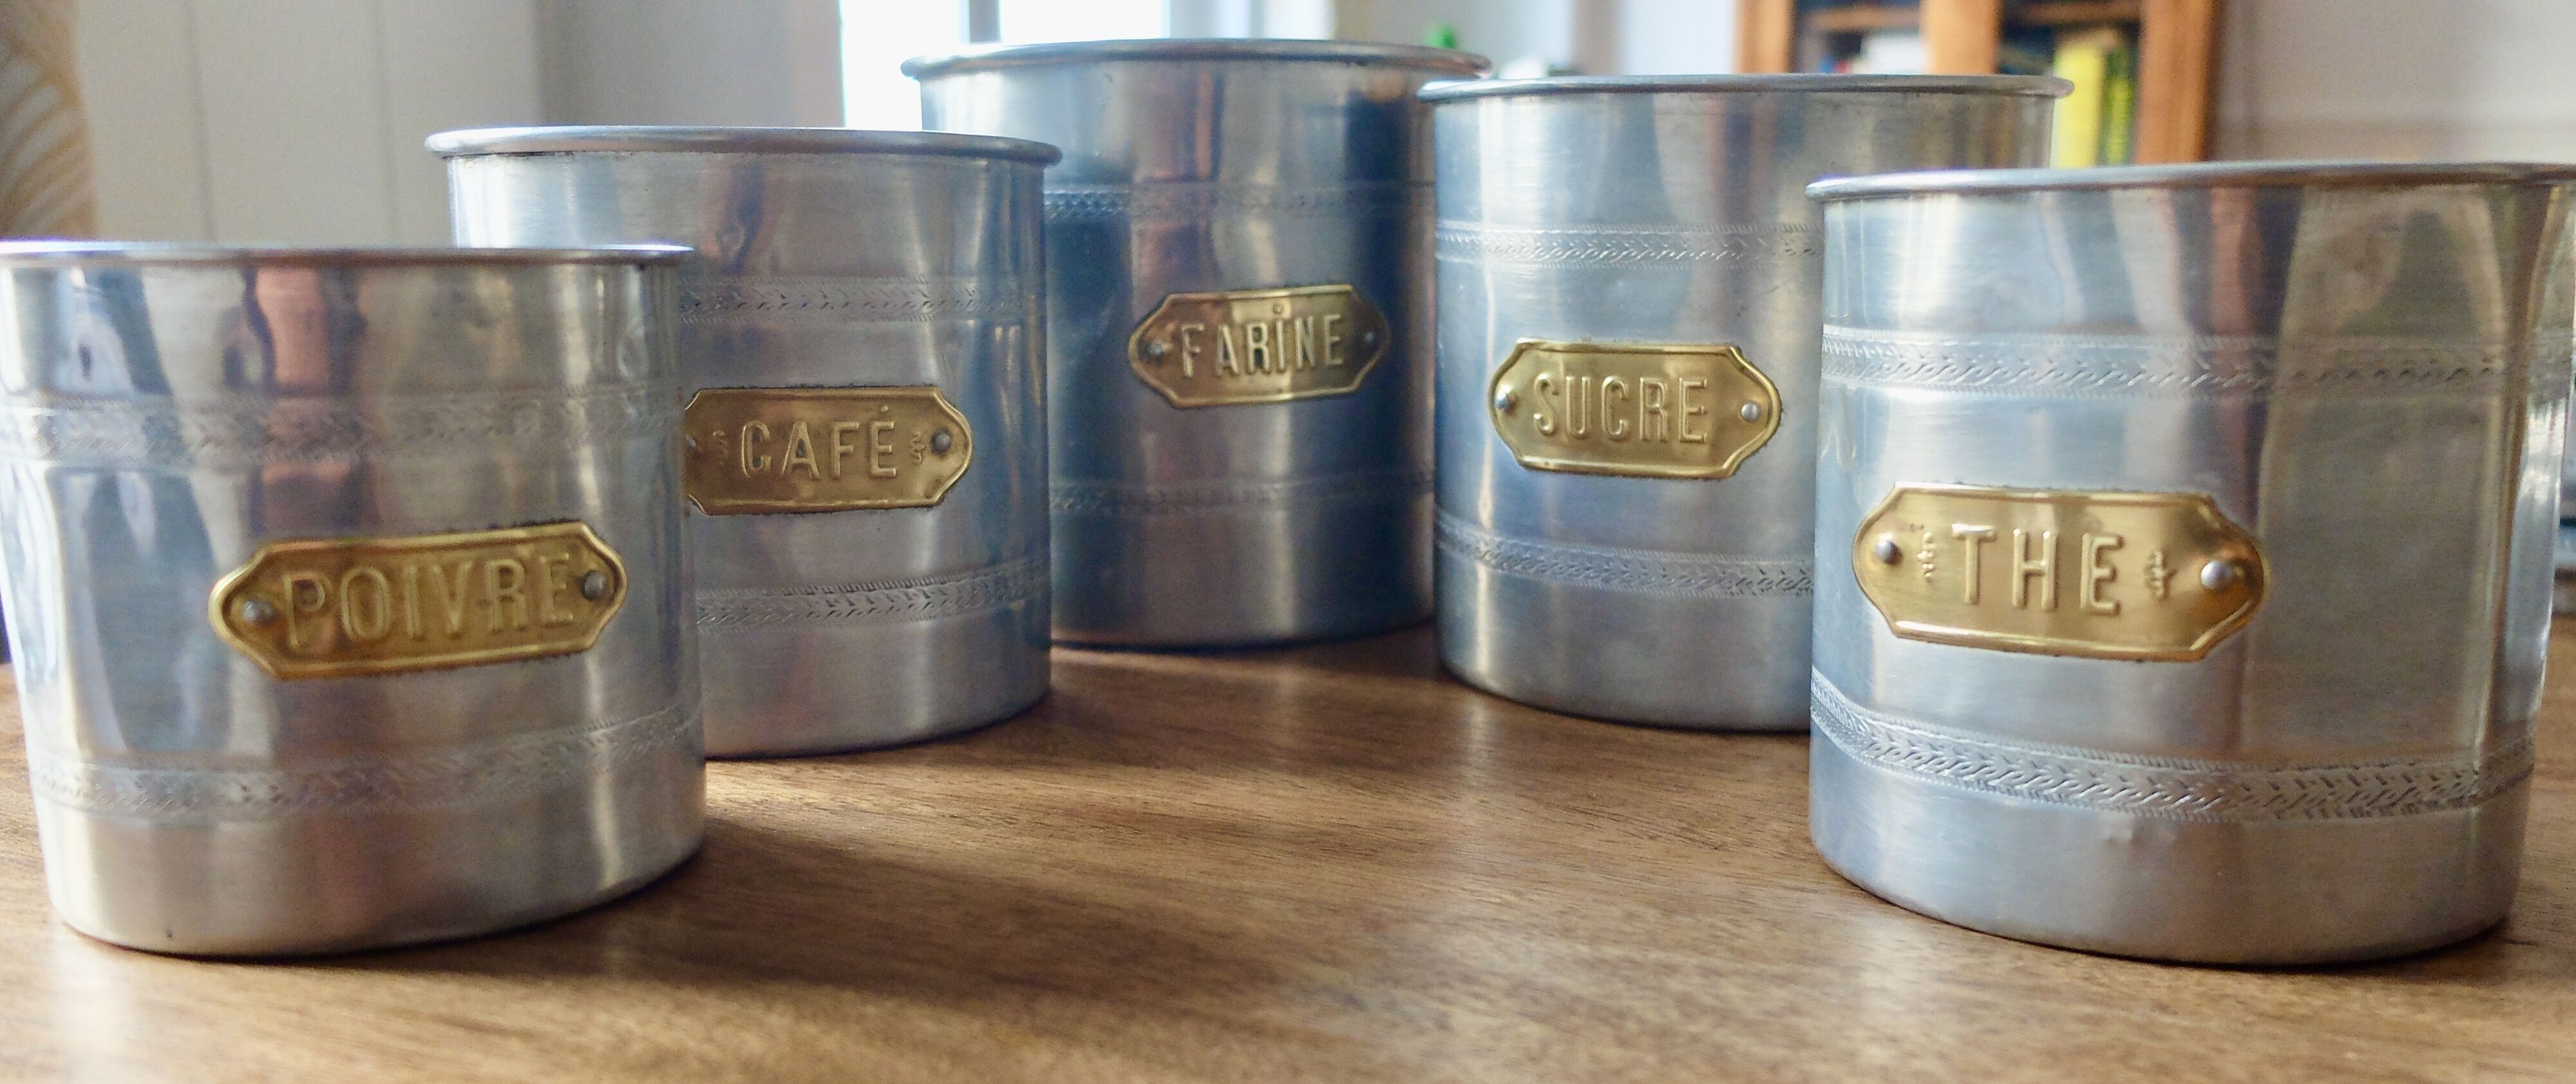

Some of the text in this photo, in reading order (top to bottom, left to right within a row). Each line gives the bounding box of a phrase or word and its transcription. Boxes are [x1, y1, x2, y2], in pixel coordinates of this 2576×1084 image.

[740, 404, 898, 479] CAFÉ
[1533, 372, 1708, 444] SUCRE
[281, 553, 575, 649] POIVRE
[1951, 522, 2124, 616] THE
